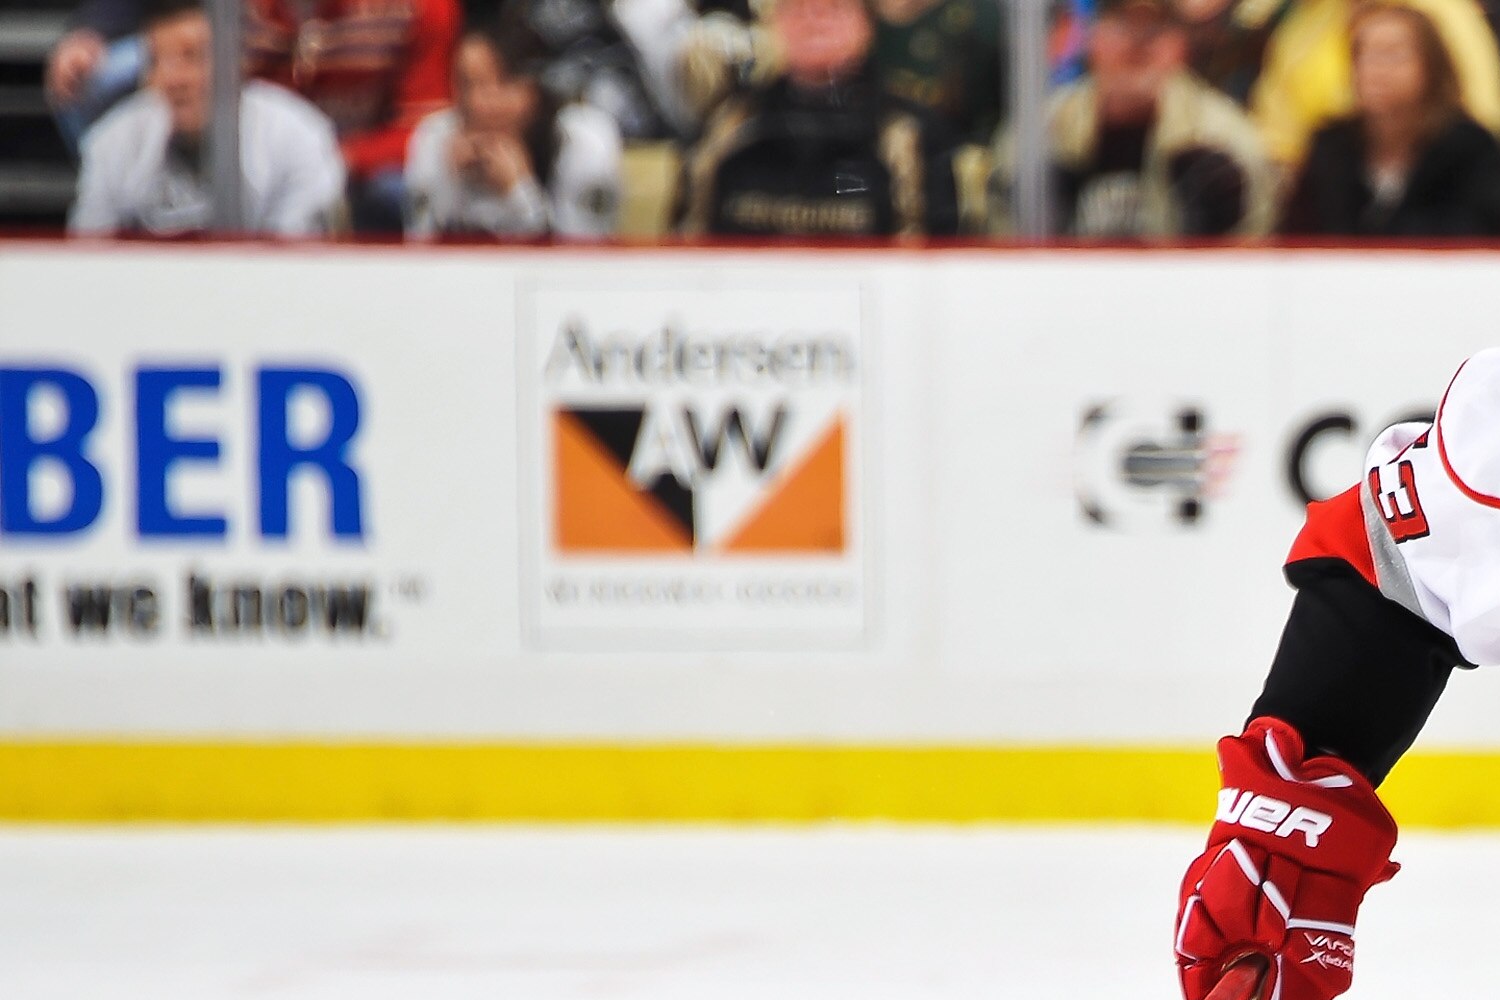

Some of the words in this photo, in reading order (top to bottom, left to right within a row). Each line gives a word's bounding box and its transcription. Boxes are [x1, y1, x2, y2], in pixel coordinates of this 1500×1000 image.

[0, 362, 368, 544] BER
[1369, 430, 1430, 544] 3
[65, 578, 157, 638] we
